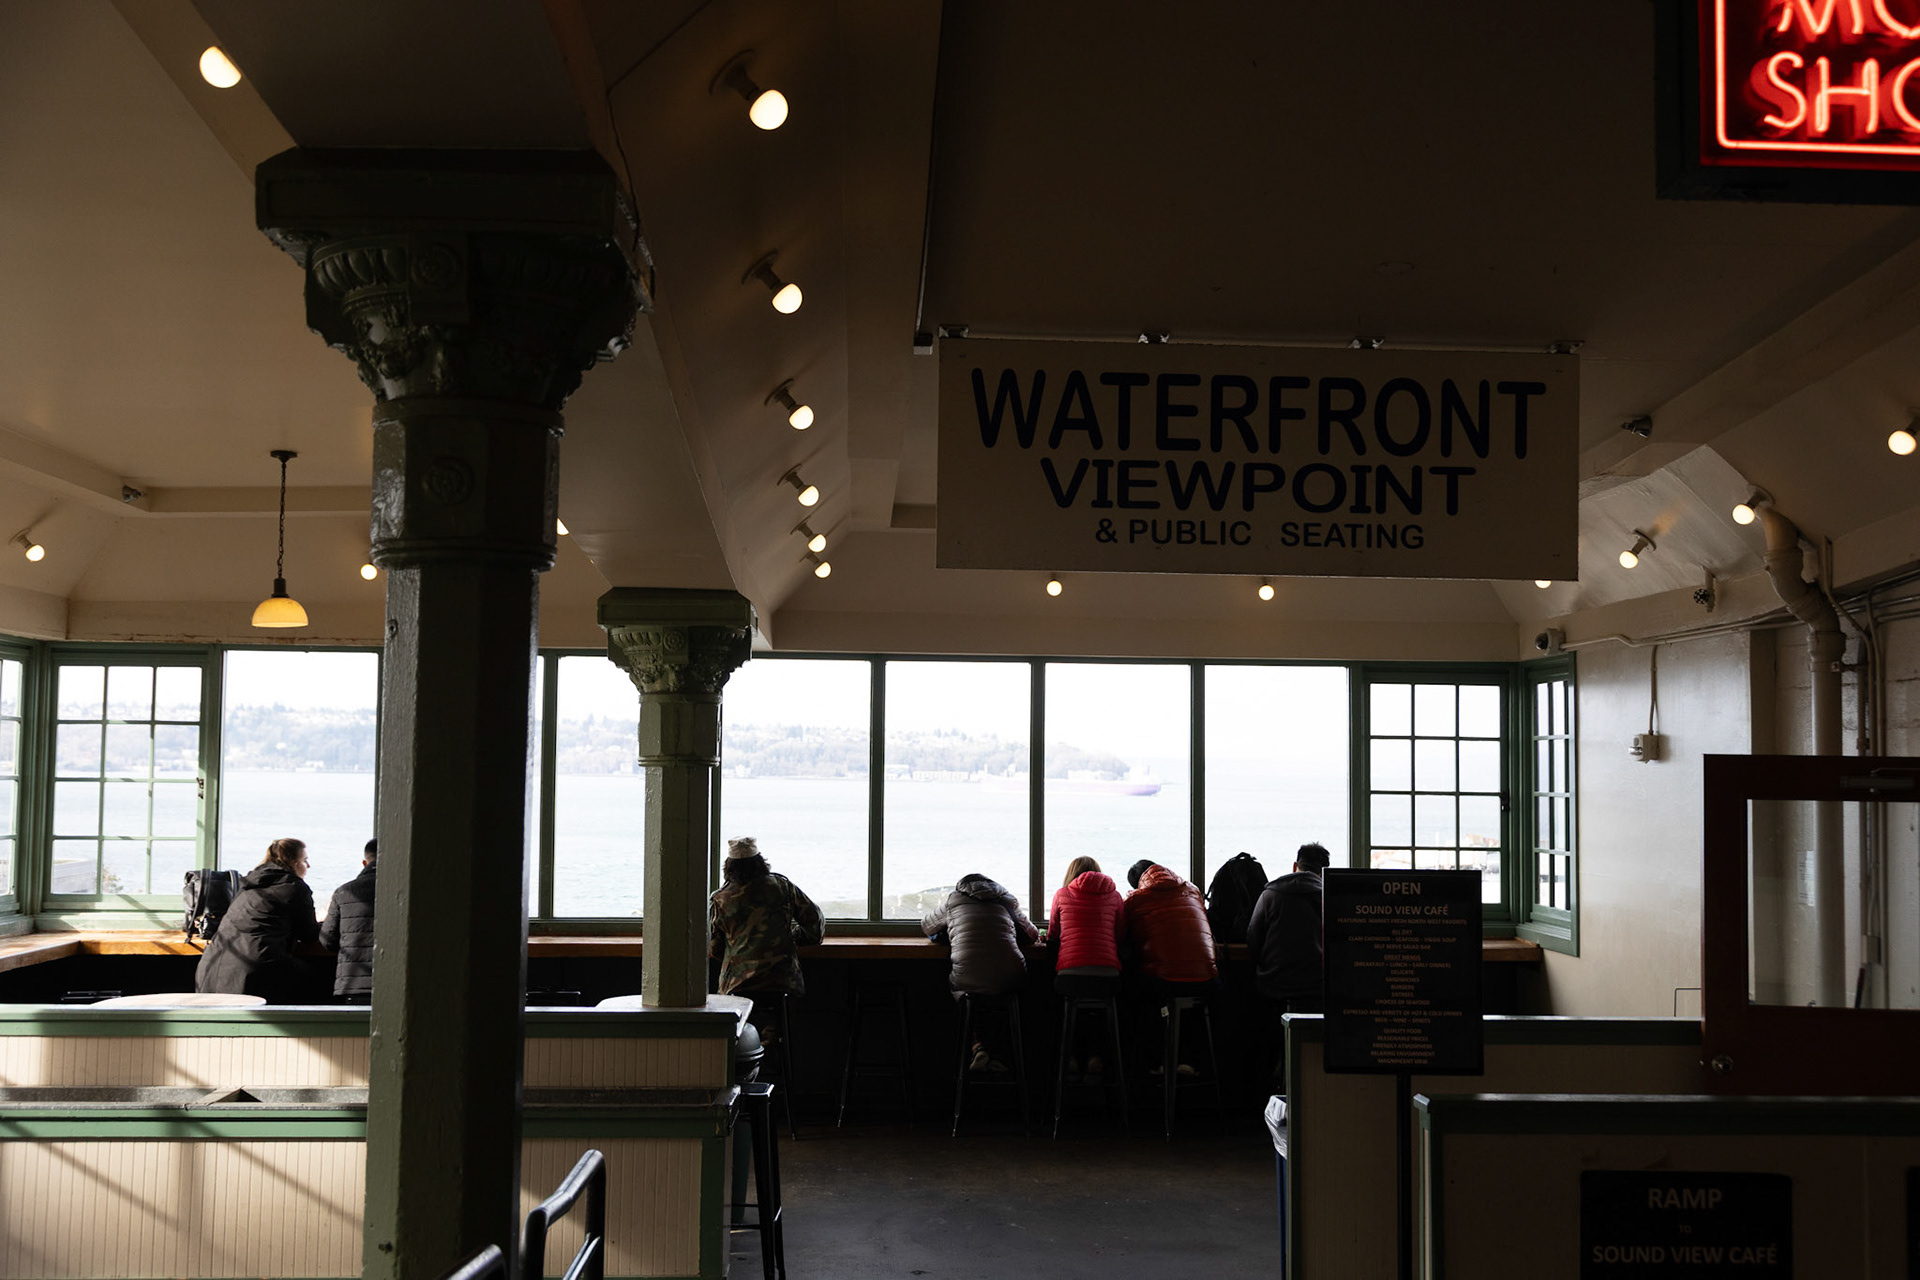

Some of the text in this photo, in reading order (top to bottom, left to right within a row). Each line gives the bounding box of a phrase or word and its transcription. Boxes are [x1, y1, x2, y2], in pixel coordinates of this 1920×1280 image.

[971, 367, 1546, 460] WATERFRONT
[1040, 457, 1476, 516] VIEWPOINT
[1096, 518, 1425, 549] & PUBLIC SEATING
[1355, 903, 1449, 916] SOUND VIEW CAFÉ
[1647, 1187, 1723, 1210] RAMP
[1679, 1224, 1692, 1234] TO
[1592, 1242, 1779, 1265] SOUND VIEW CAFÉ
